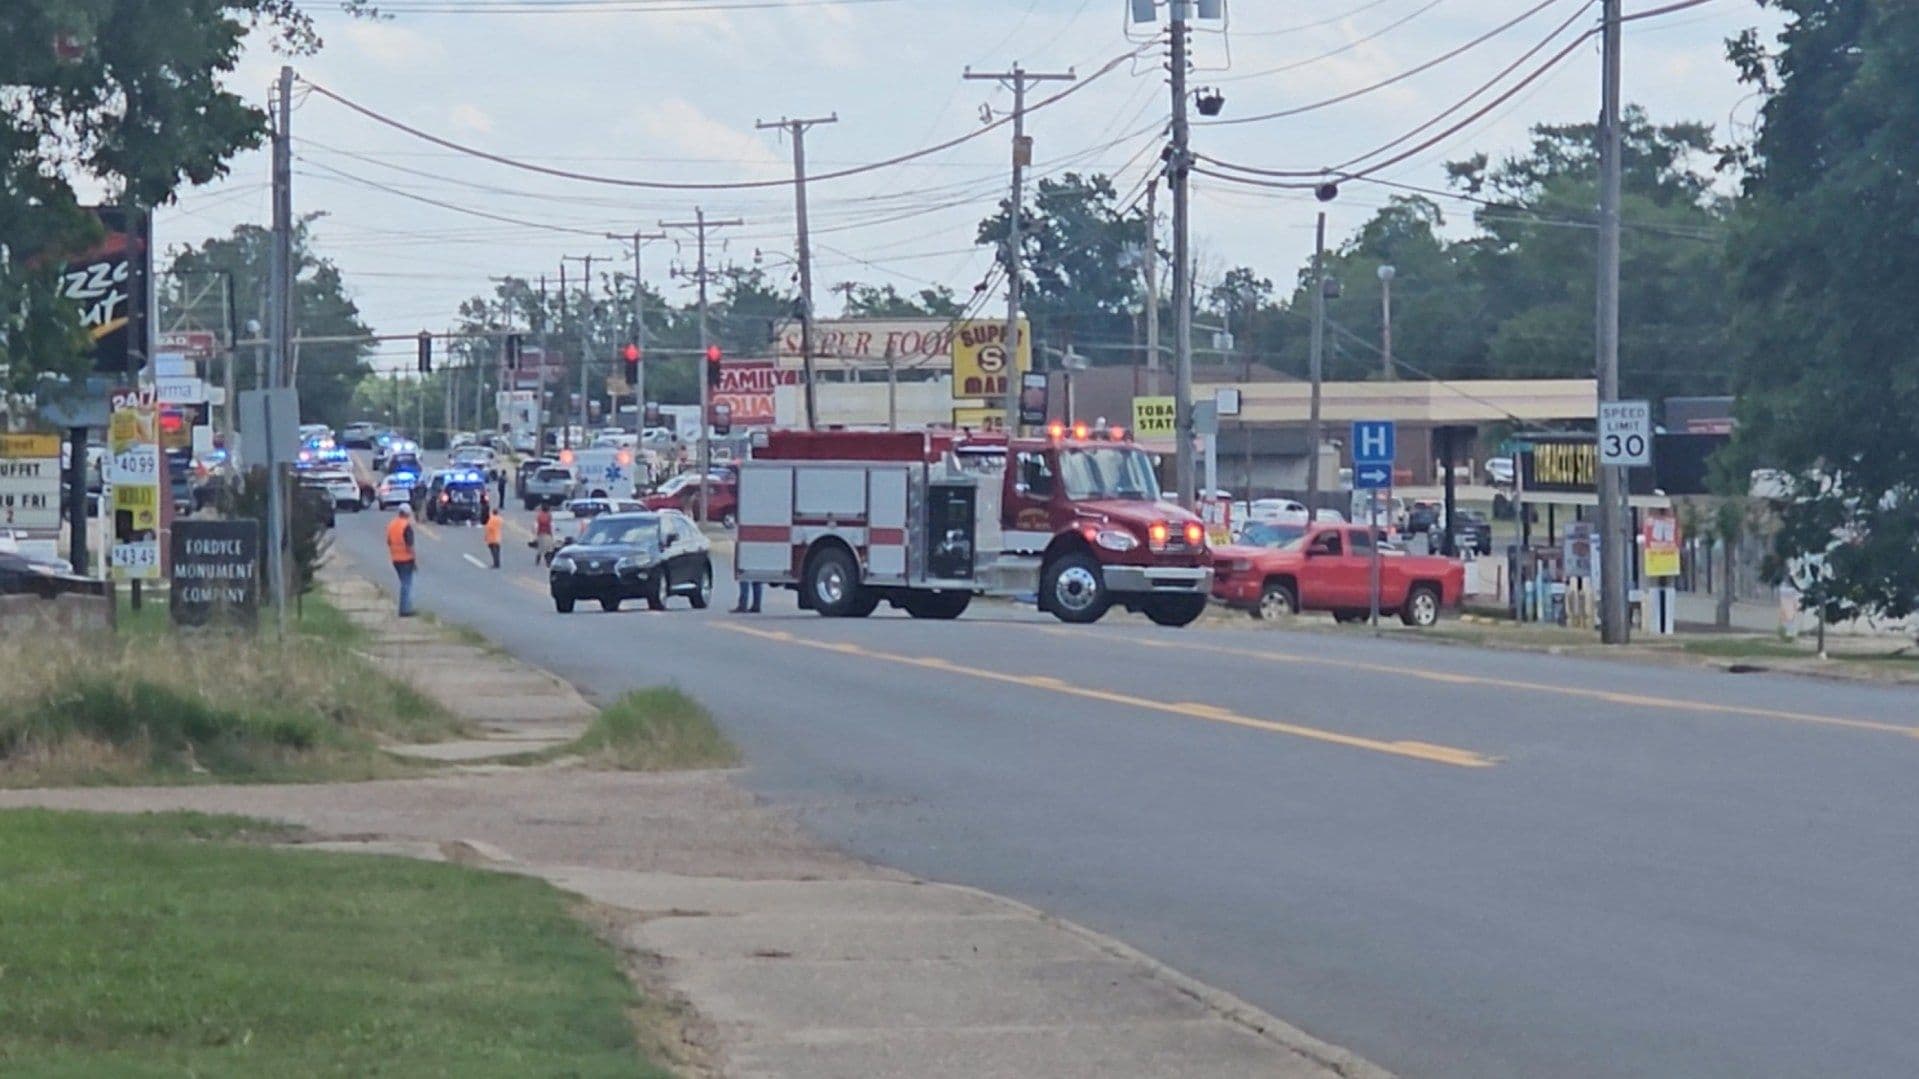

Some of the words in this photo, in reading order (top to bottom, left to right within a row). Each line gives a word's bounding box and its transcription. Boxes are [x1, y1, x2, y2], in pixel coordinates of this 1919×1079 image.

[1136, 405, 1174, 417] TOBA
[1604, 408, 1645, 419] SPEED
[1139, 418, 1177, 430] STAT
[1606, 420, 1640, 431] LIMIT
[1362, 426, 1386, 457] H
[1605, 434, 1644, 458] 30
[22, 494, 46, 508] FRI
[185, 538, 243, 555] FORDYCE
[174, 562, 254, 579] MONUMENT
